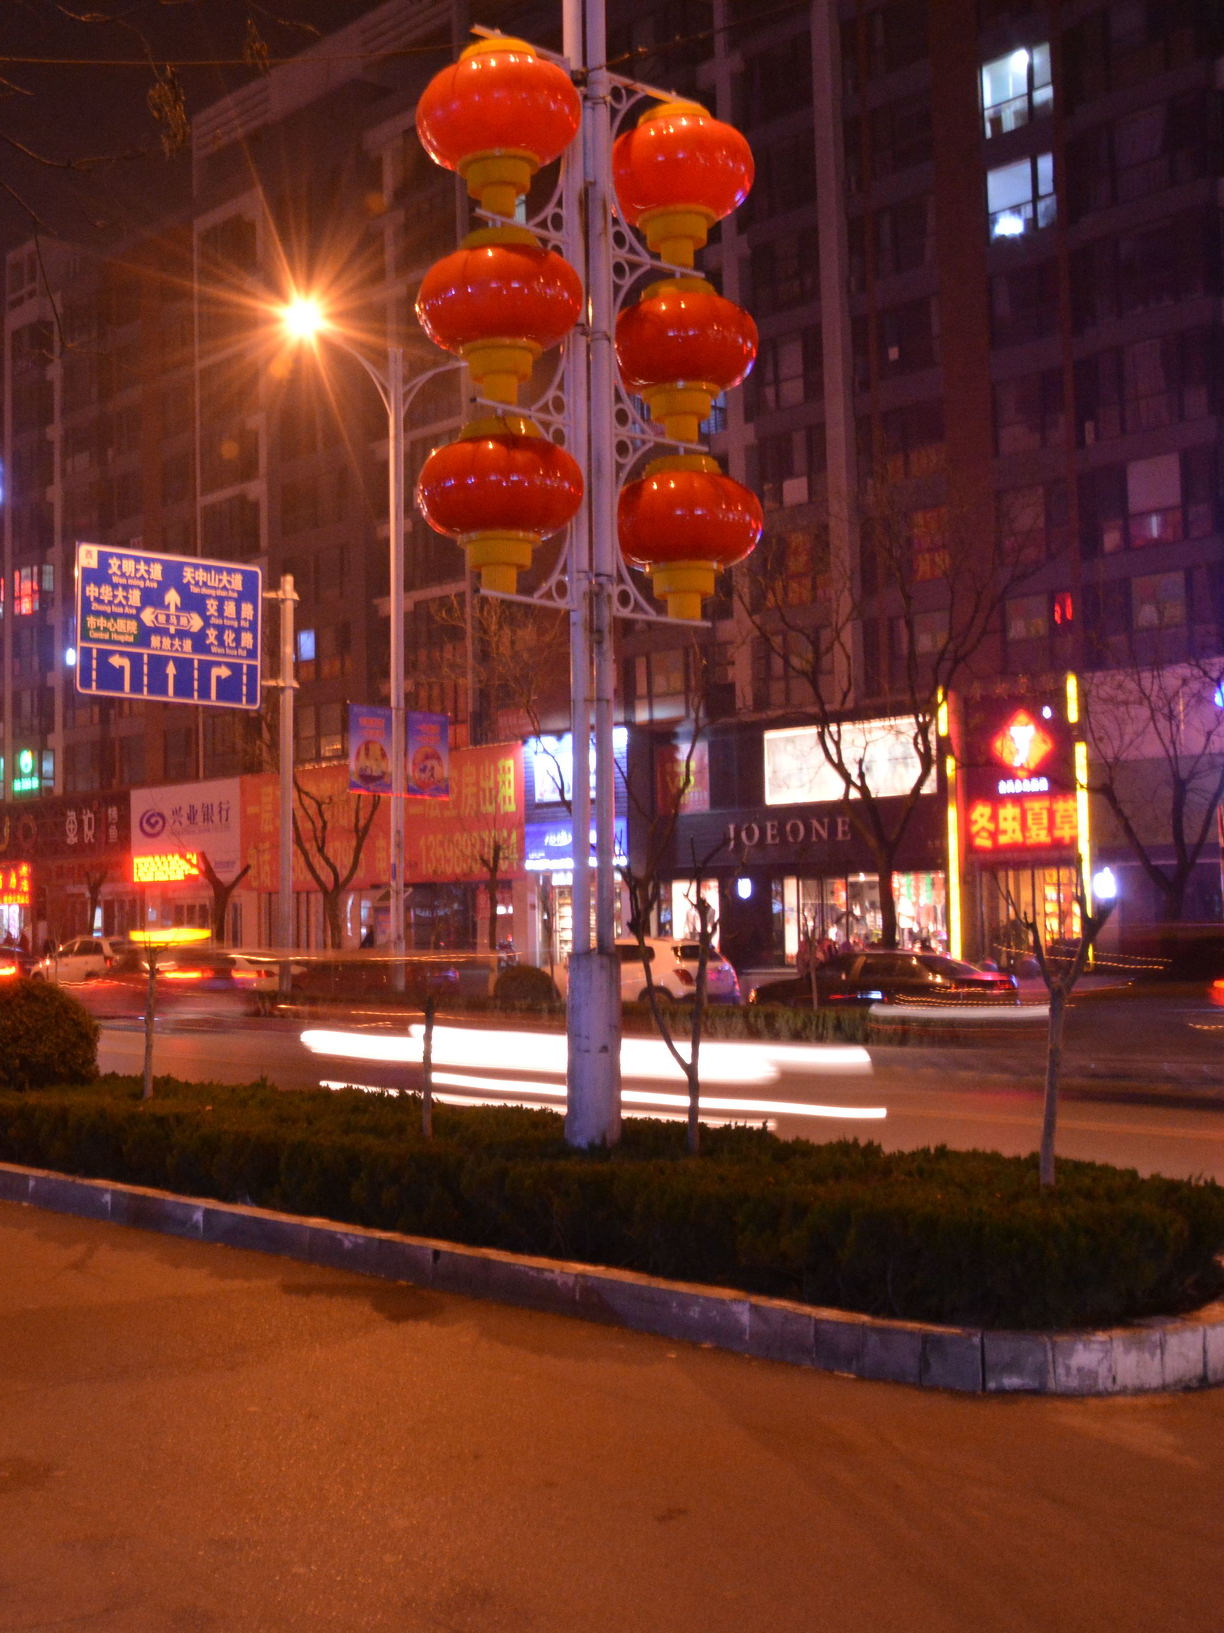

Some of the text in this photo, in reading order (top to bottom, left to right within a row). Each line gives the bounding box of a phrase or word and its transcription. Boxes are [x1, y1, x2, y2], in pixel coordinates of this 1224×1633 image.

[108, 556, 163, 581] 文明大道
[183, 566, 243, 591] 天中山大道
[86, 582, 141, 607] 中华大道
[206, 598, 254, 620] 交通路
[86, 614, 138, 634] 市中心医院
[150, 634, 193, 652] 解放大道
[206, 627, 253, 649] 文化路
[171, 801, 231, 827] 兴业银行
[970, 799, 1077, 848] 冬虫夏草
[727, 816, 852, 851] JOEONE
